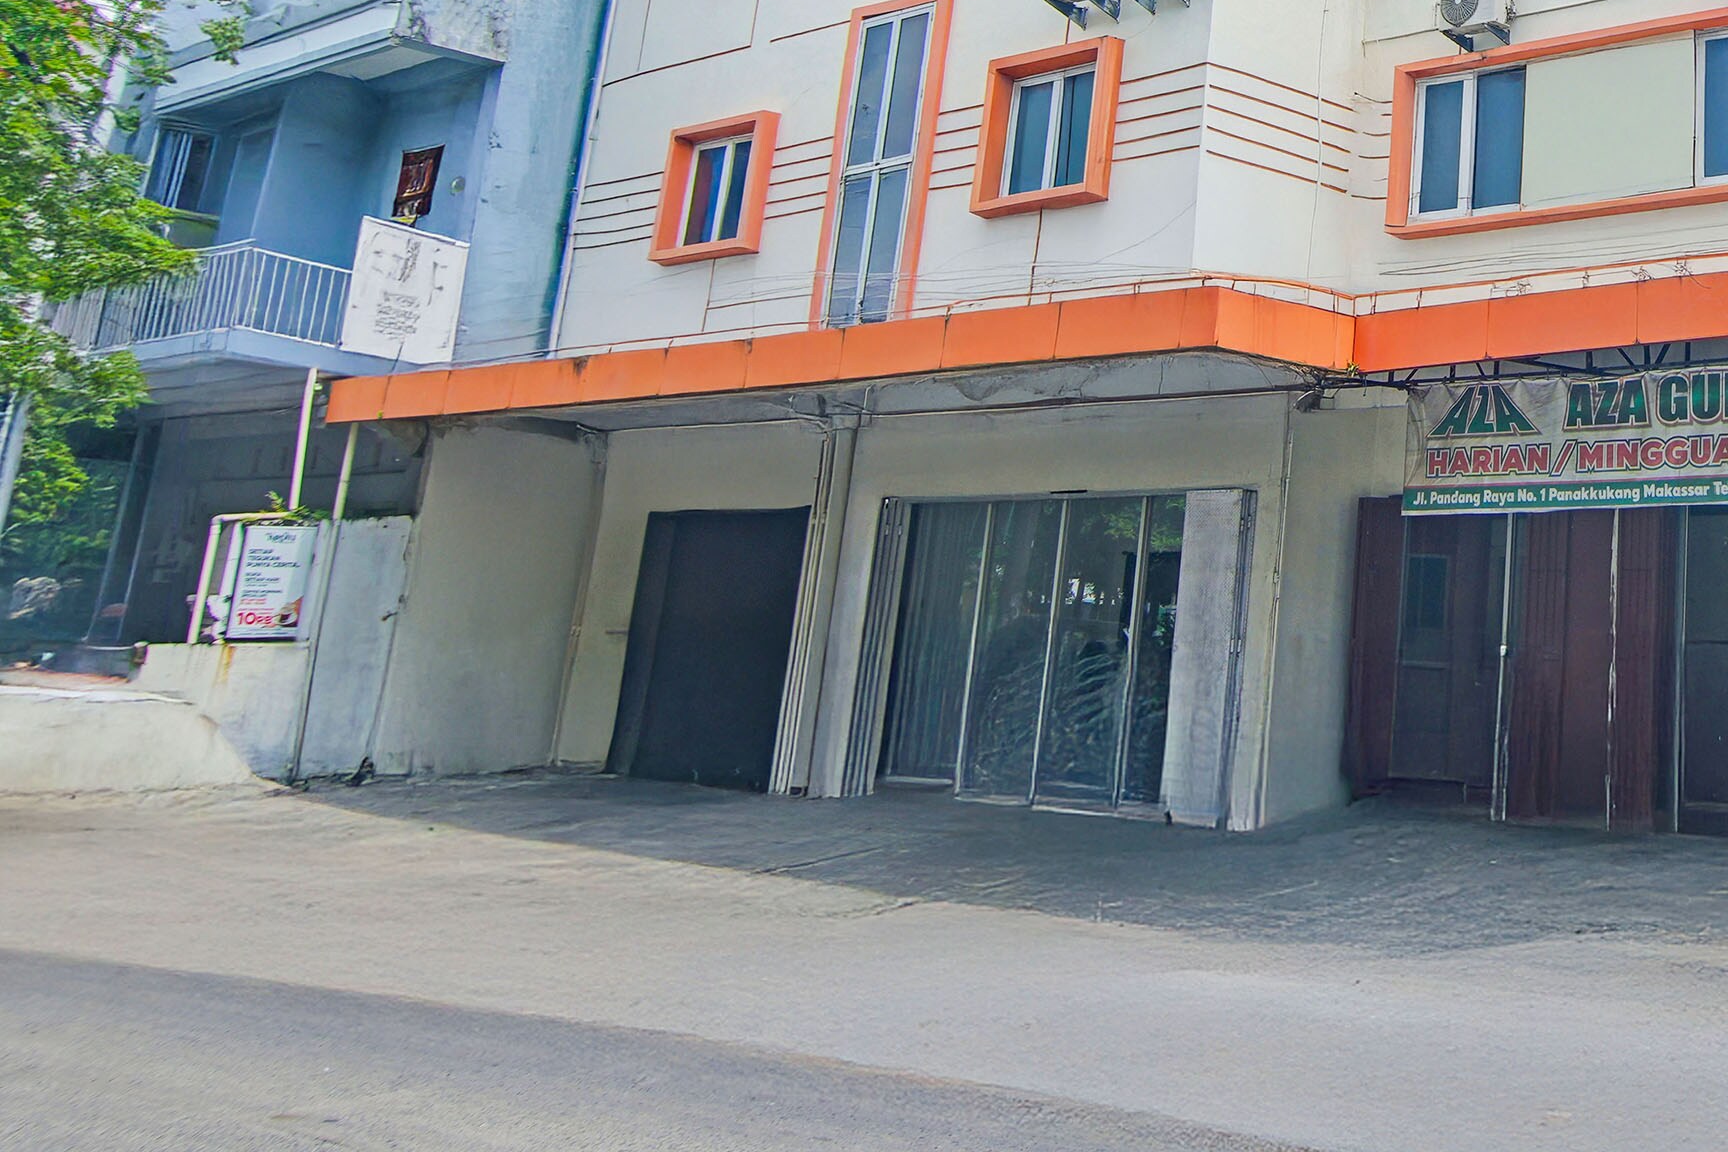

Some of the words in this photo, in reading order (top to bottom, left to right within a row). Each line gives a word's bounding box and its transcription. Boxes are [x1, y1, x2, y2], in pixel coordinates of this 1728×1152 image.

[1428, 384, 1540, 437] AZA
[1564, 378, 1651, 430] AZA
[1427, 443, 1551, 477] HARIAN
[1430, 490, 1481, 506] Pandang
[1483, 489, 1514, 506] Raya
[1517, 488, 1537, 501] No.
[1540, 487, 1546, 500] 1
[1549, 485, 1640, 503] Panakkukang
[1643, 483, 1710, 499] Makassar
